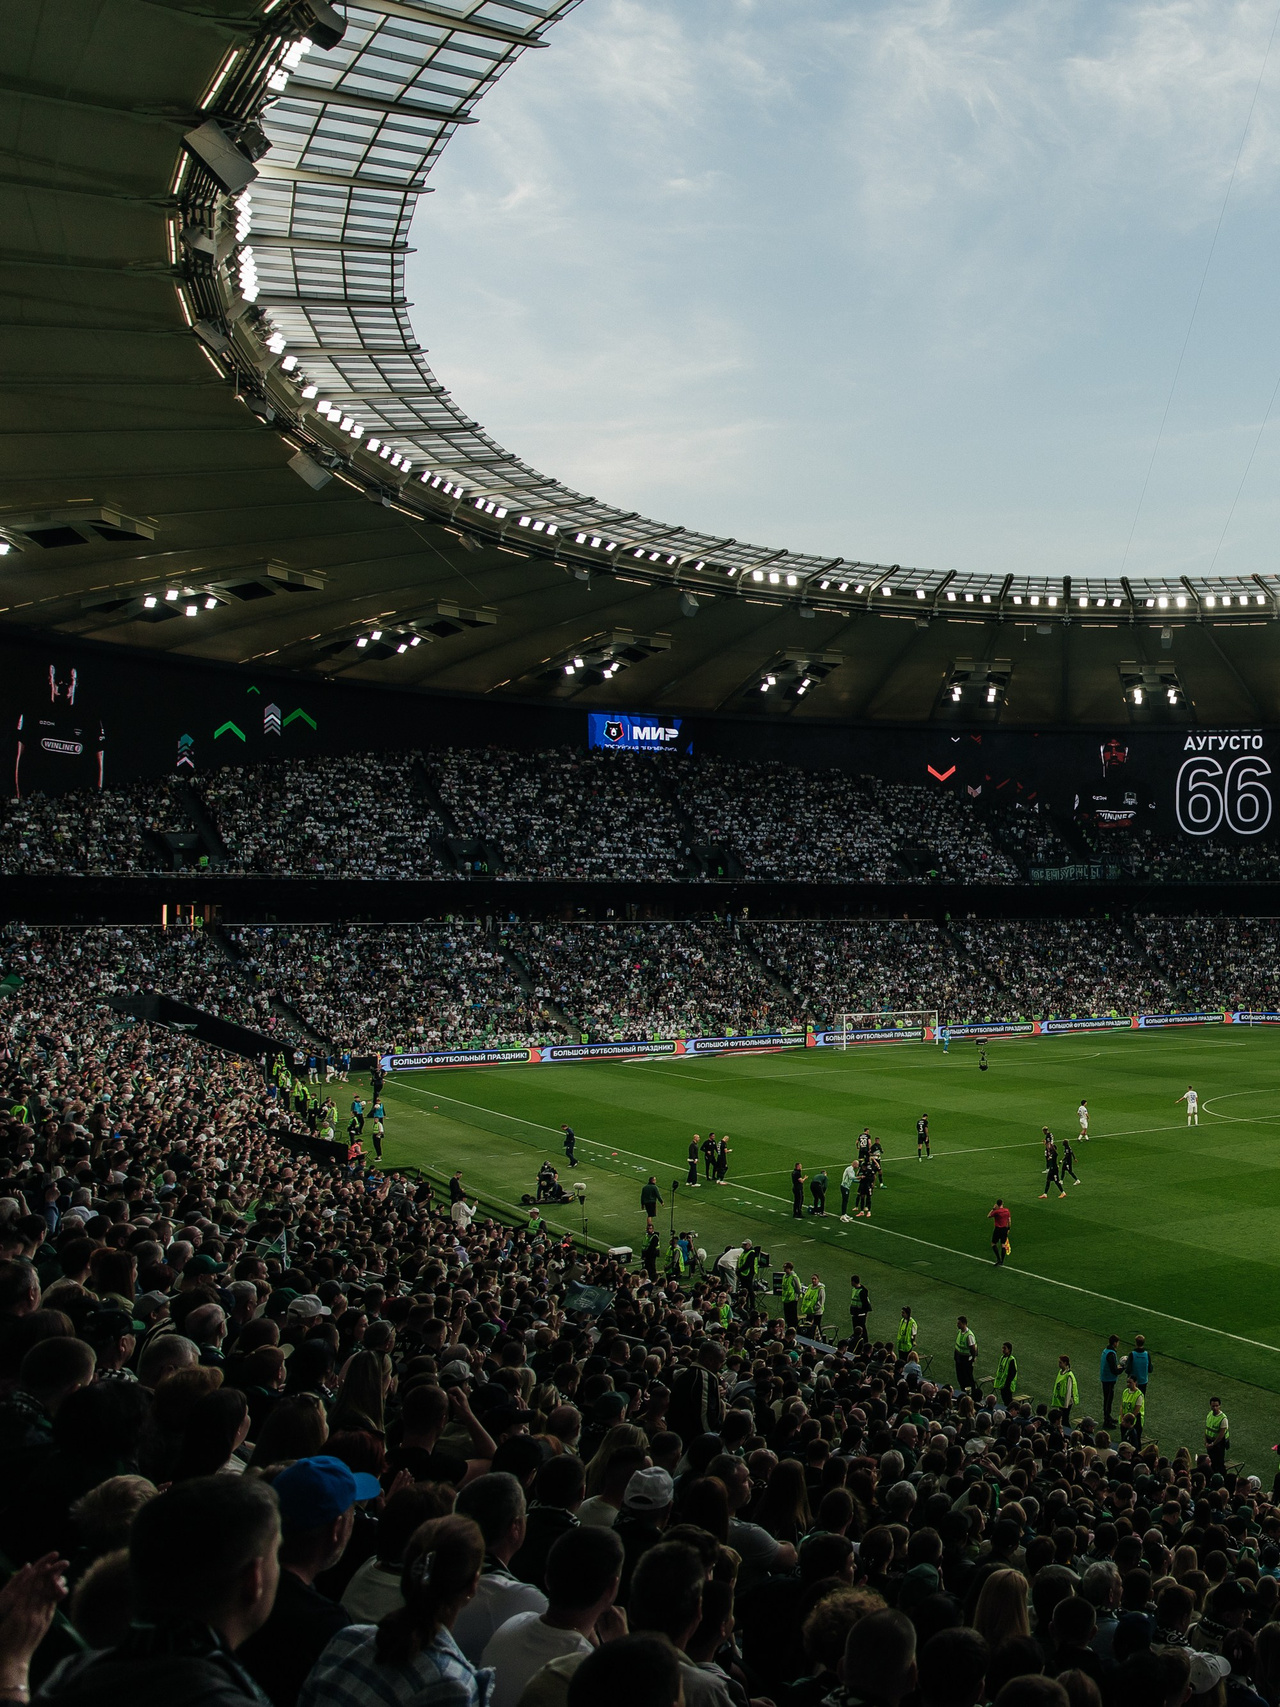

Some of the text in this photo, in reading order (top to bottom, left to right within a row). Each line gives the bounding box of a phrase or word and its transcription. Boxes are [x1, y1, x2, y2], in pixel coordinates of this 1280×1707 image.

[633, 726, 679, 741] МИР
[44, 741, 75, 751] WINLINE
[1183, 735, 1263, 750] АУГУСТО
[1175, 756, 1272, 835] 66
[894, 1030, 922, 1039] ПРАЗДНИК
[553, 1043, 674, 1057] БОЛЬШОЙ ФУТБОЛЬНЫЙ ПРАЗДНИК!
[393, 1051, 527, 1066] БОЛЬШОЙ ФУТБОЛЬНЫЙ ПРАЗДНИК!
